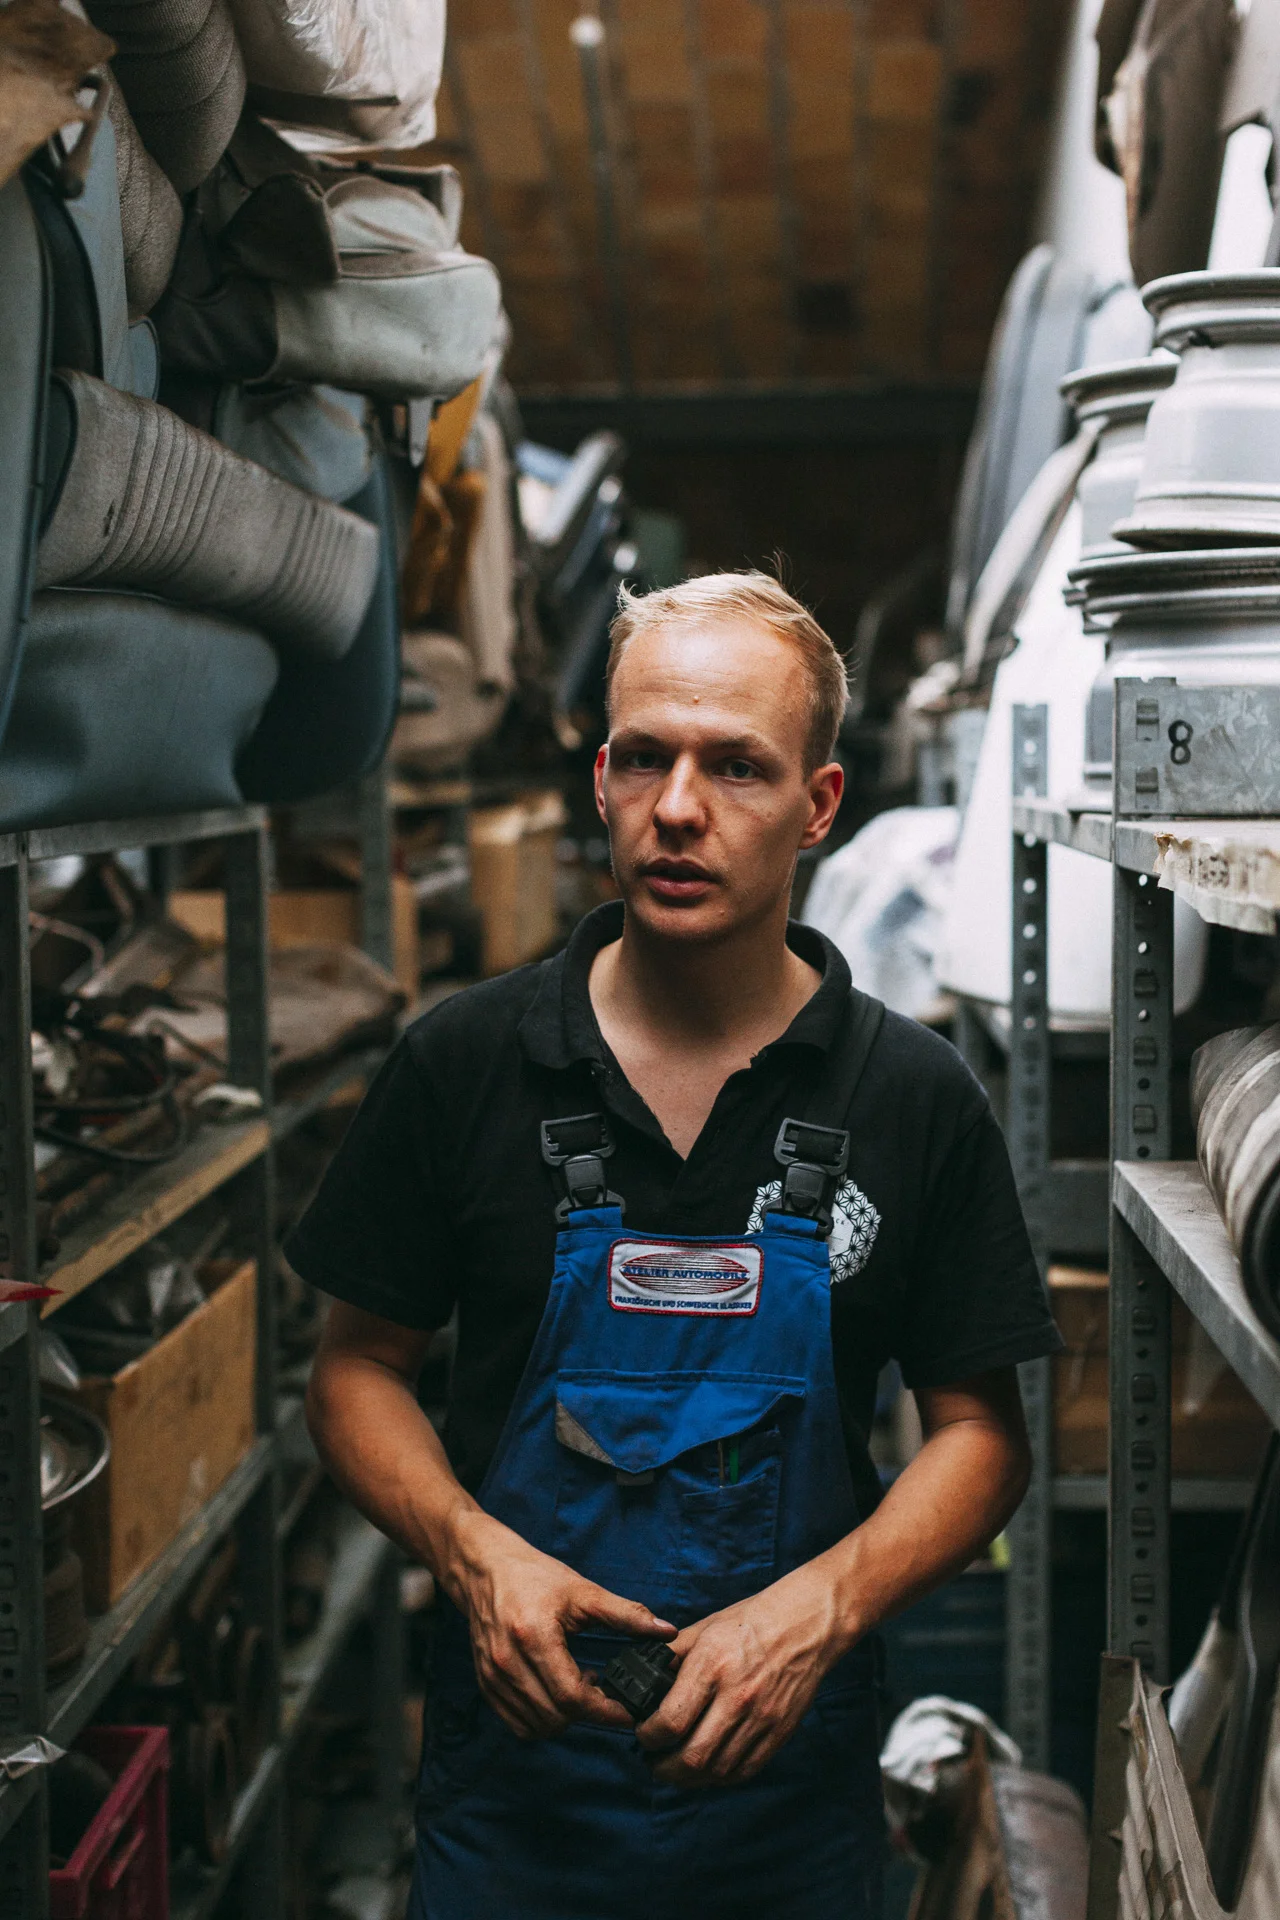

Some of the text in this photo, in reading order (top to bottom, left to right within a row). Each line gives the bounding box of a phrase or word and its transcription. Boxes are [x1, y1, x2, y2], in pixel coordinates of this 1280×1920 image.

[1168, 720, 1193, 765] 8
[624, 1266, 747, 1279] ATELIER AUTOMOBILE
[662, 1300, 676, 1308] UND
